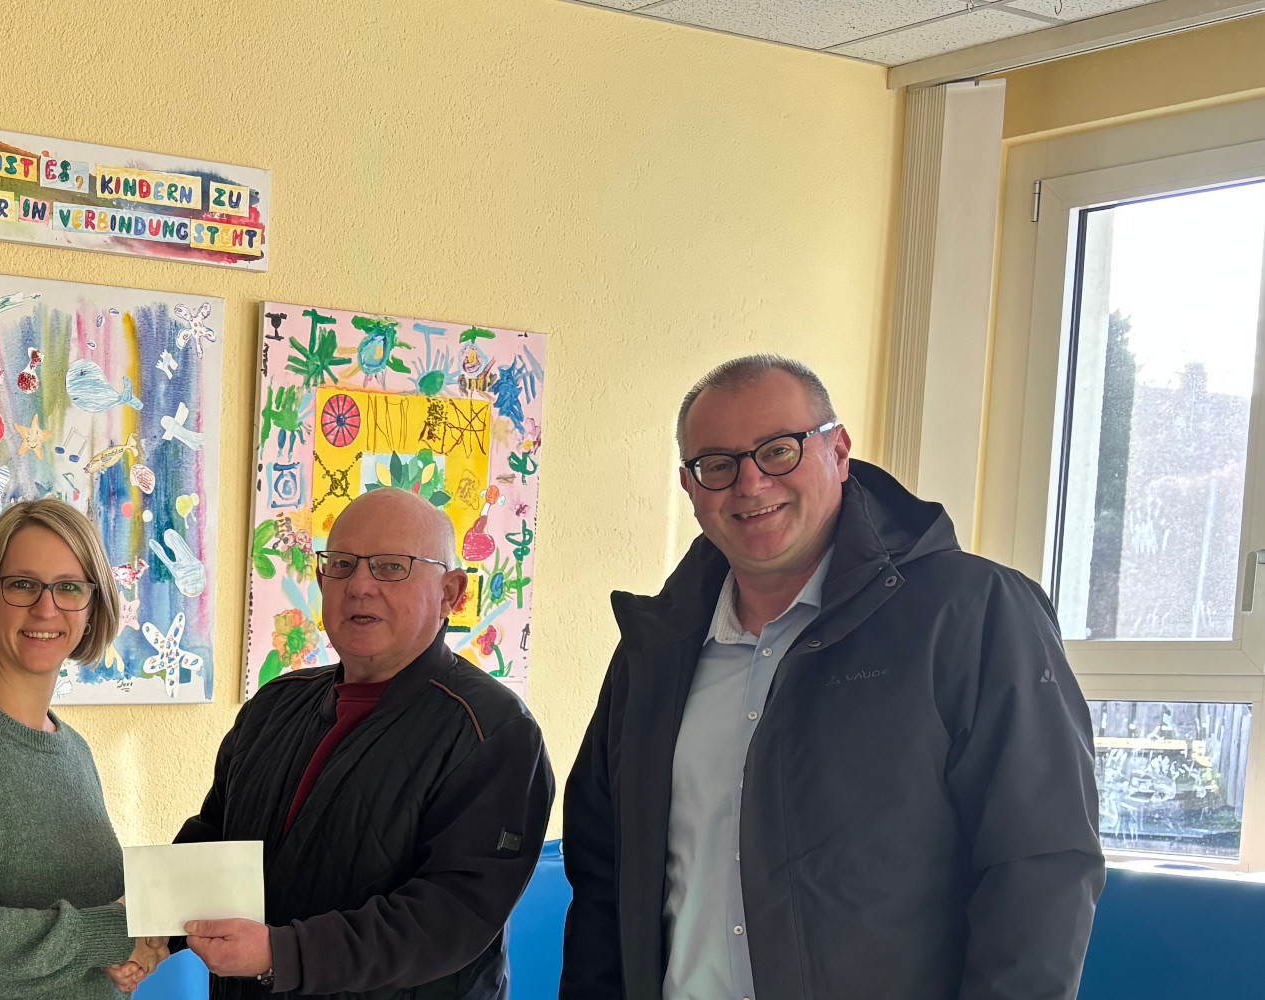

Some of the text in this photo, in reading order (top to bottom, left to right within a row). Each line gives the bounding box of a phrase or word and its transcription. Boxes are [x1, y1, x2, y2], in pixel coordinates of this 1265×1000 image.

[44, 159, 84, 189] ES,
[100, 174, 193, 204] KINDERN
[212, 187, 242, 209] ZU
[22, 198, 47, 221] IN
[59, 208, 190, 241] VERBINDUNG
[193, 223, 258, 249] STEHT
